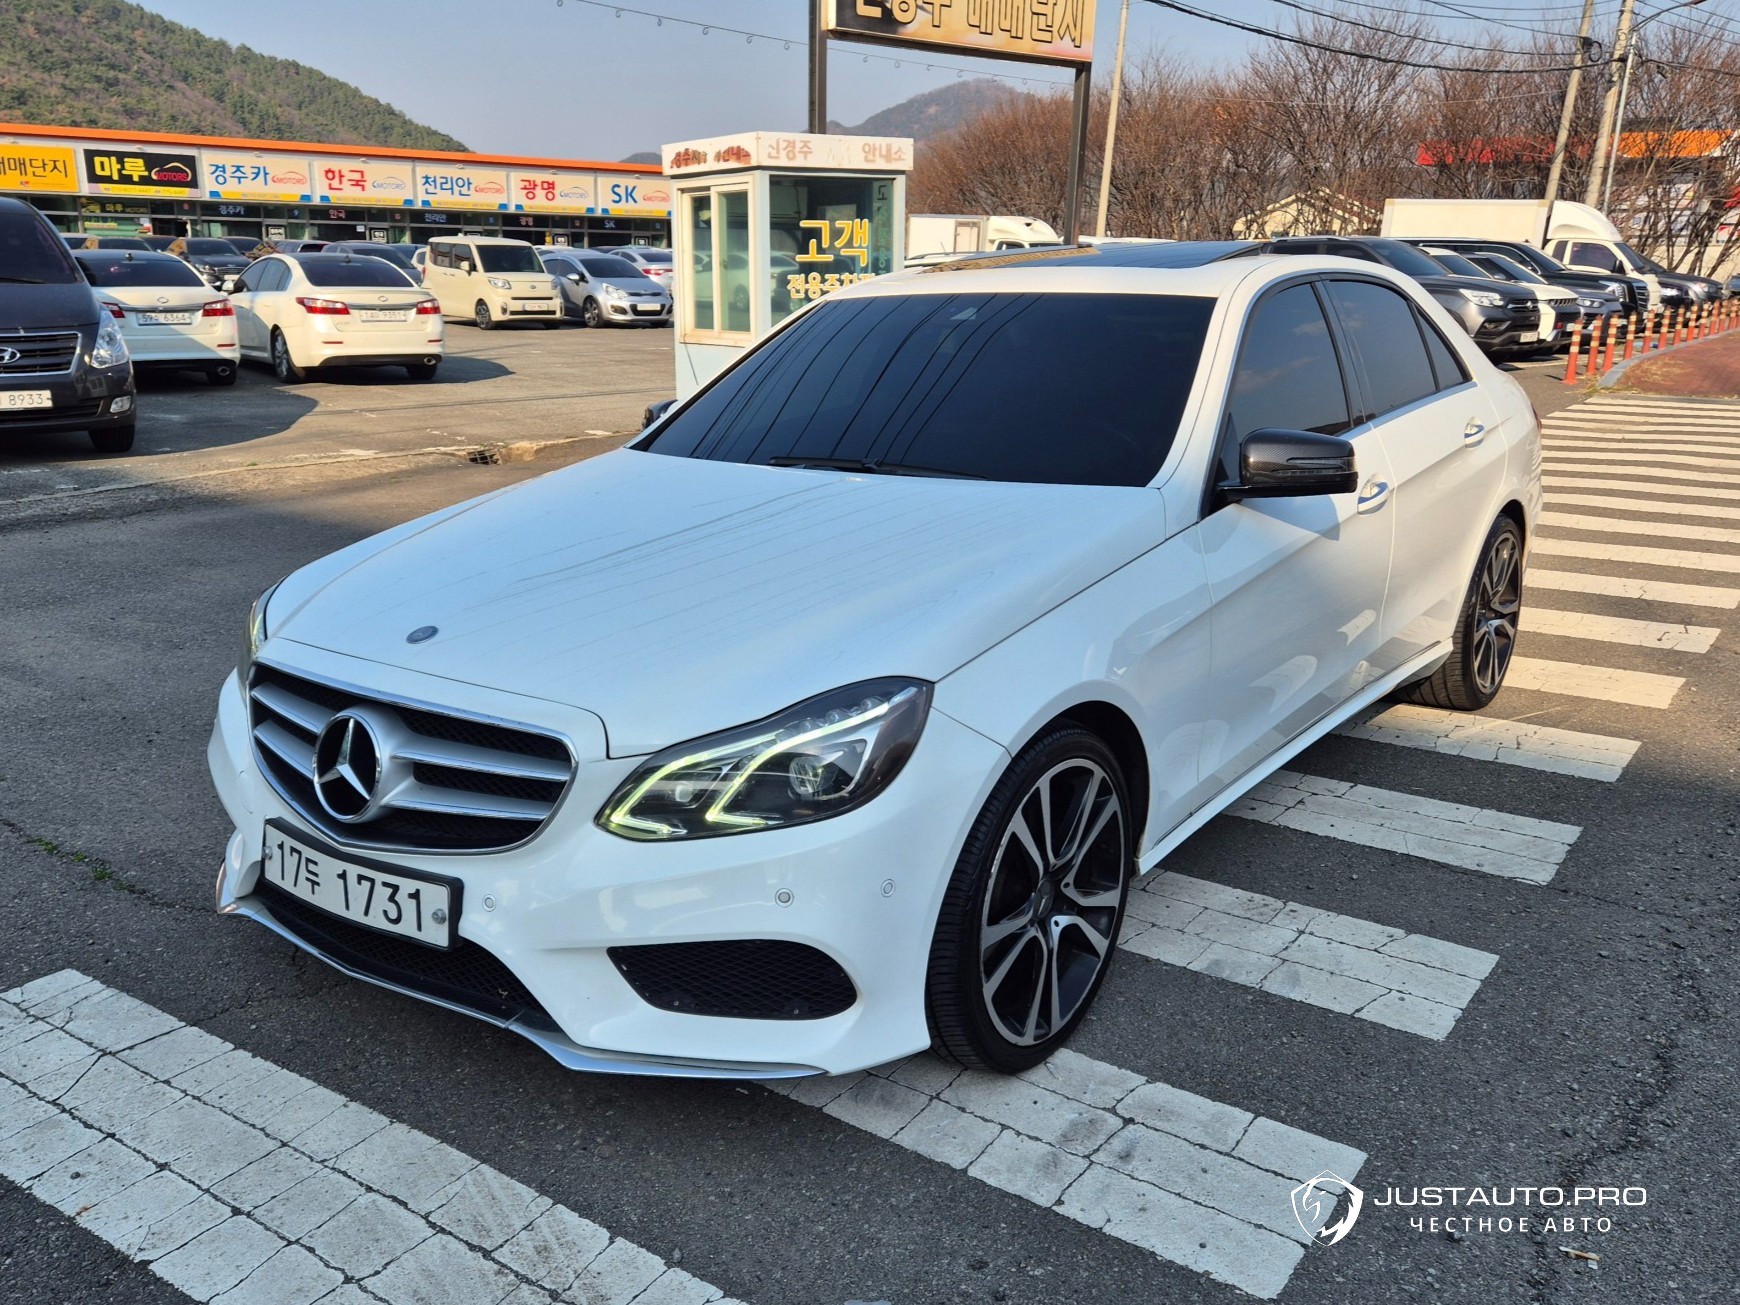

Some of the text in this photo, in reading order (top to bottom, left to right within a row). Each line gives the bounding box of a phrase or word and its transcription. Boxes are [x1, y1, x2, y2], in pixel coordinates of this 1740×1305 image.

[767, 138, 813, 161] 신경주
[862, 142, 906, 163] 안내소
[93, 156, 189, 182] 마루 MOTORS
[209, 163, 307, 186] 경주카 MOTORS
[323, 168, 405, 191] 한국 MOTORS
[421, 175, 473, 196] 천리안
[520, 179, 556, 201] 광명
[611, 184, 638, 204] SK
[218, 205, 245, 215] 경주카
[604, 219, 616, 228] SK
[795, 218, 869, 267] 고객
[8, 393, 44, 406] 8933
[276, 840, 422, 932] 17두 1731
